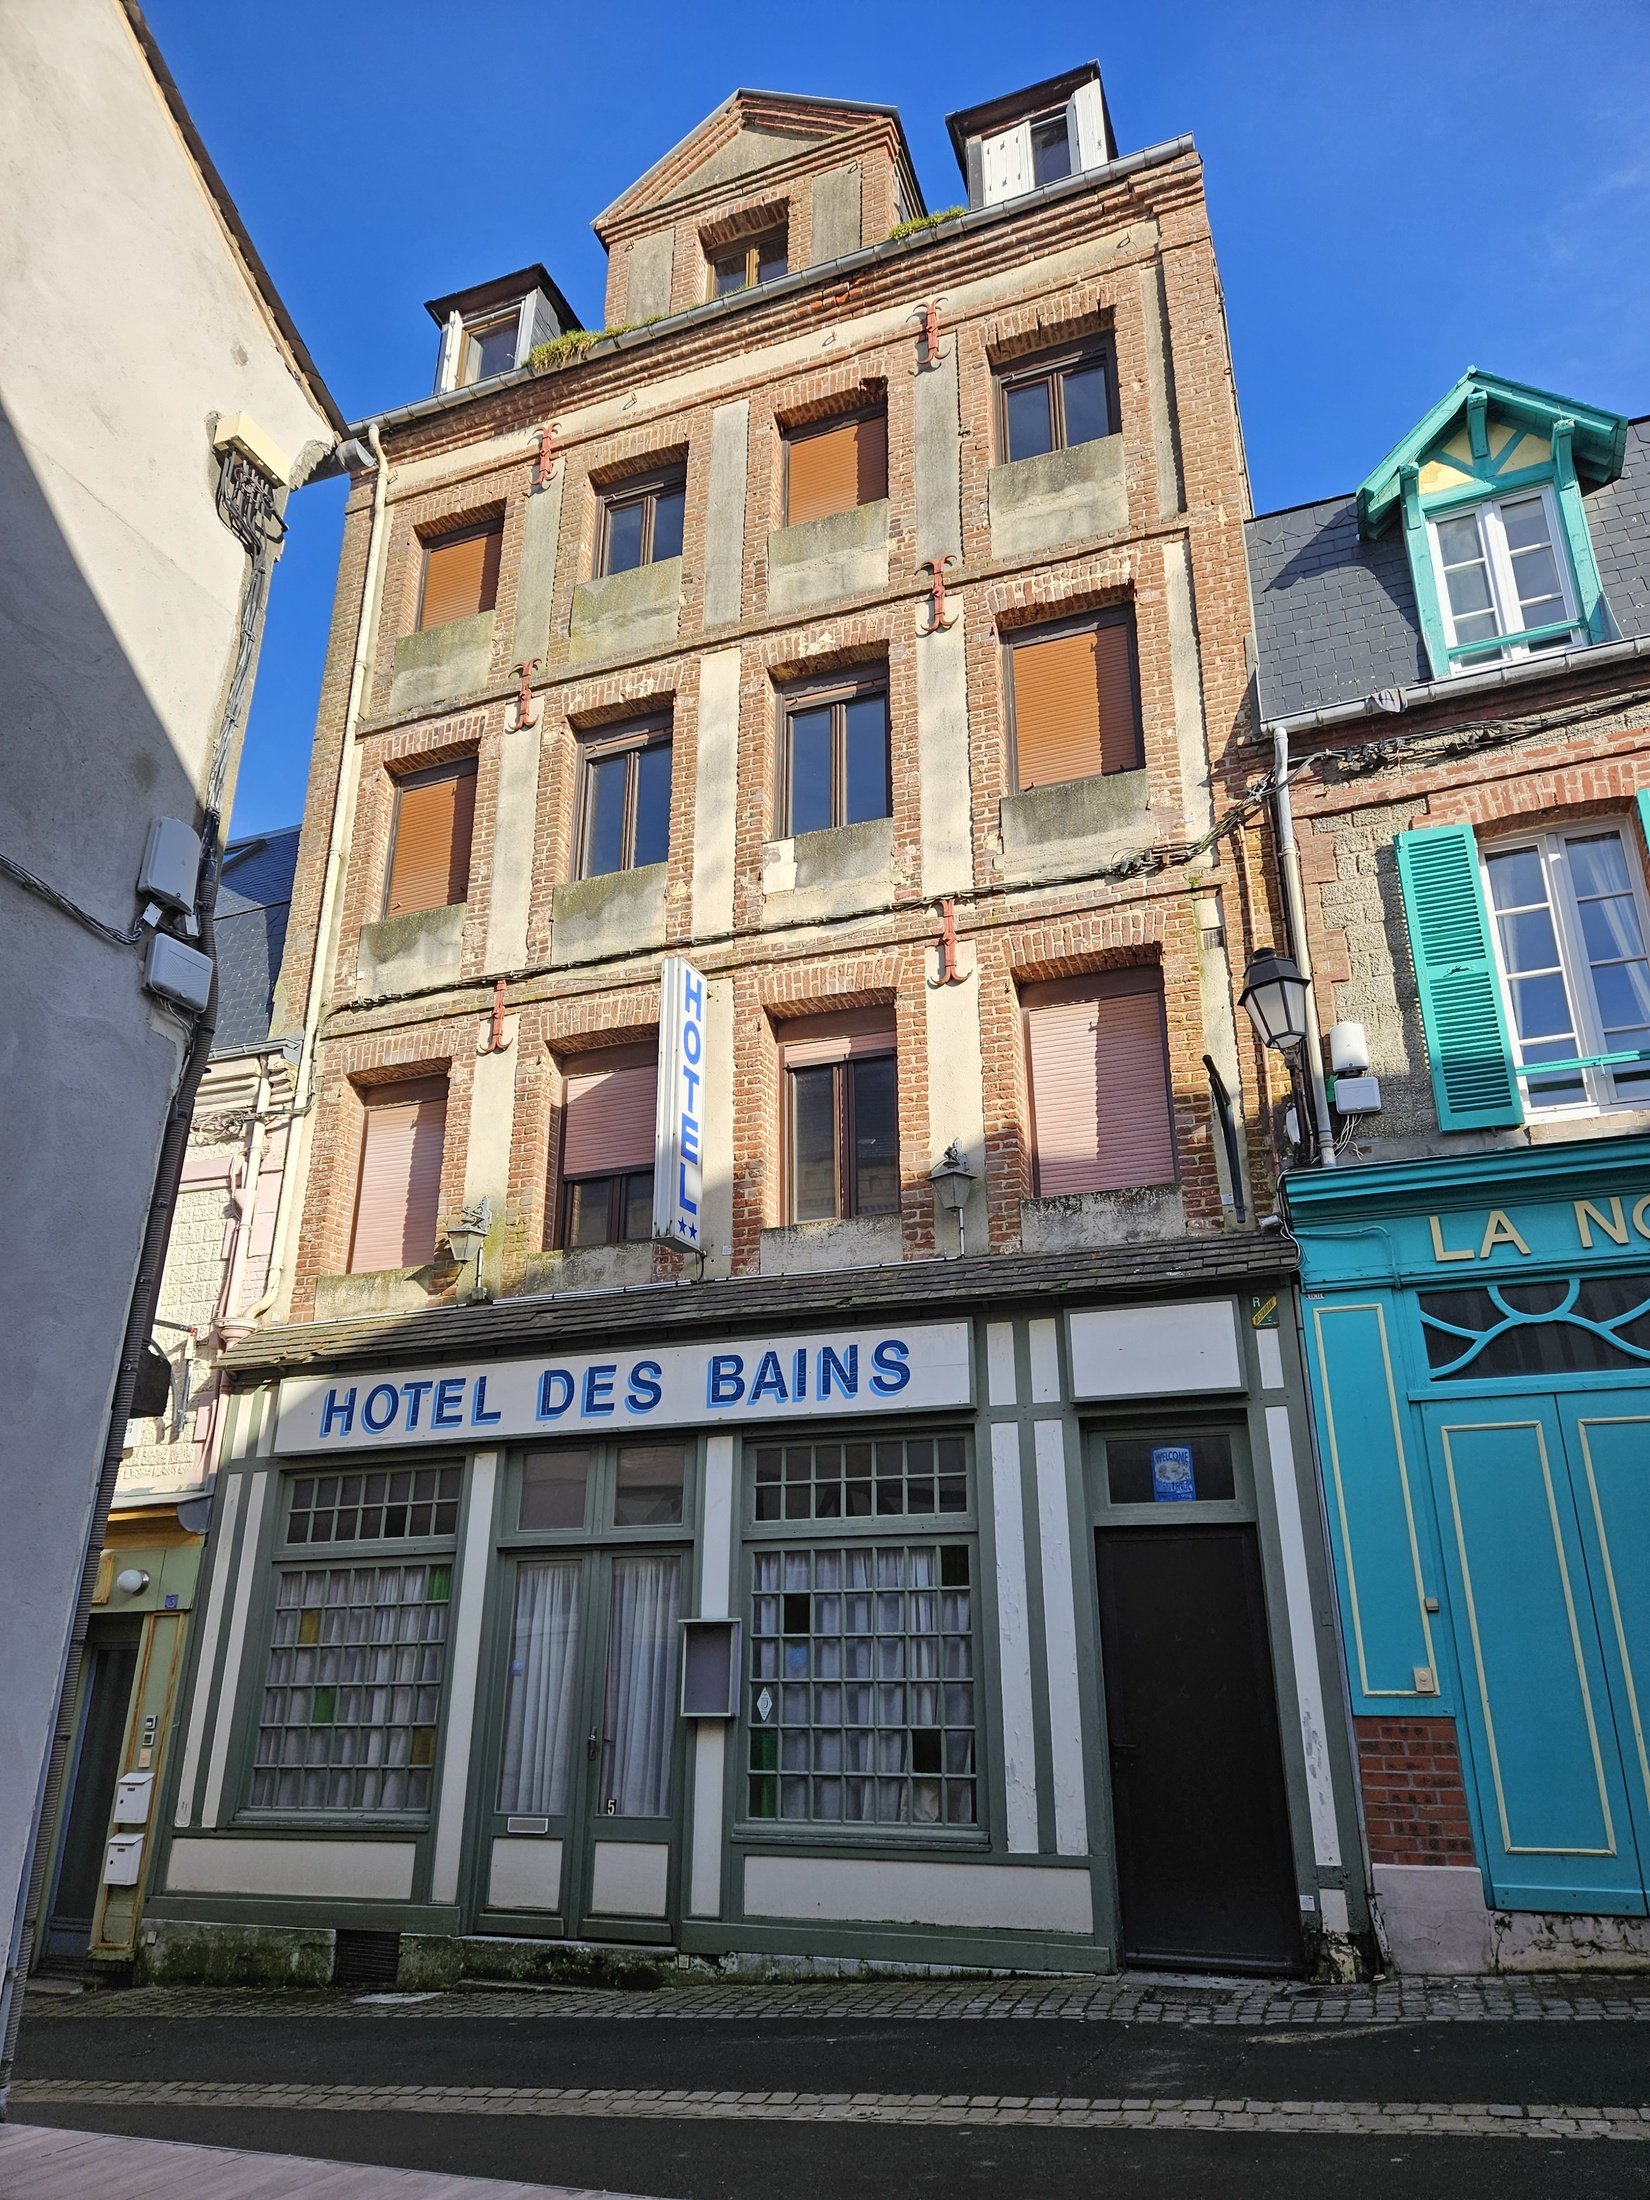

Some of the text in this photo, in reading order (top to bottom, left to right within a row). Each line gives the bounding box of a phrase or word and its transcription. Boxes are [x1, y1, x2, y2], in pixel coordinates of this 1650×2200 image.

[680, 969, 703, 1215] HOTEL
[1428, 1210, 1532, 1262] LA
[1252, 1296, 1261, 1308] R
[319, 1339, 912, 1439] HOTEL DES BAINS
[1154, 1450, 1188, 1464] WELCOME
[607, 1799, 615, 1815] 5
